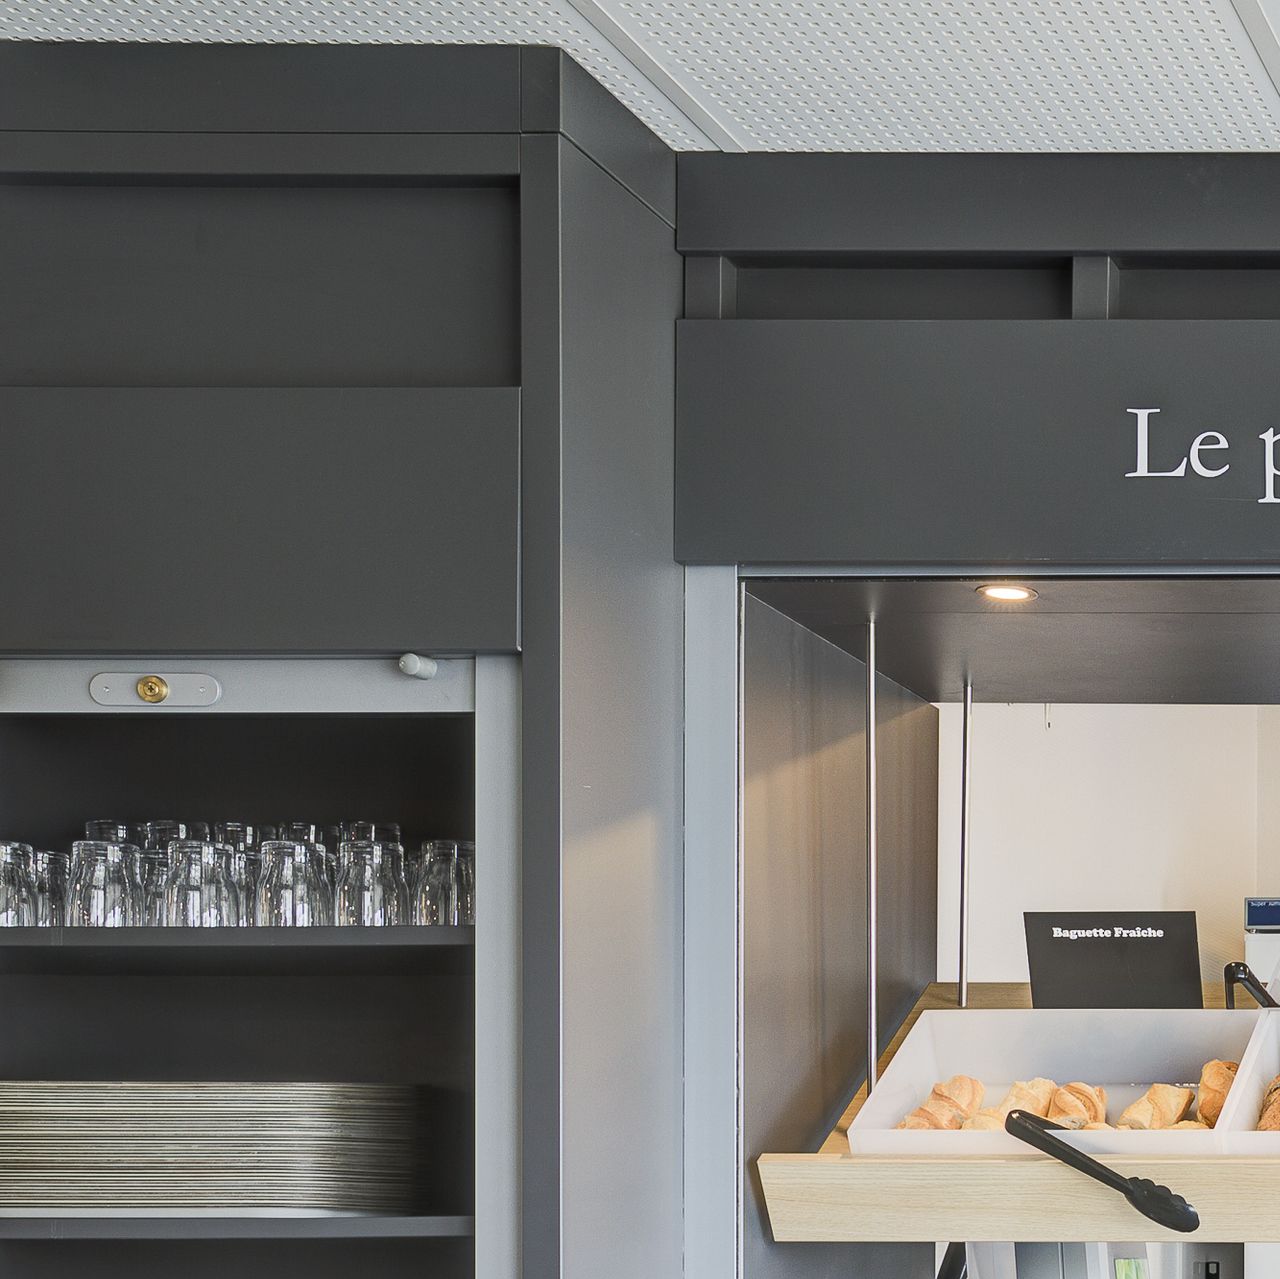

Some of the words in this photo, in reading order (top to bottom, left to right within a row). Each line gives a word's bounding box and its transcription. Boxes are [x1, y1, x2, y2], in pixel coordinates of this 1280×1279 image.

[1124, 407, 1230, 478] Le
[1052, 926, 1112, 940] Baguette
[1113, 926, 1165, 938] Fraîche
